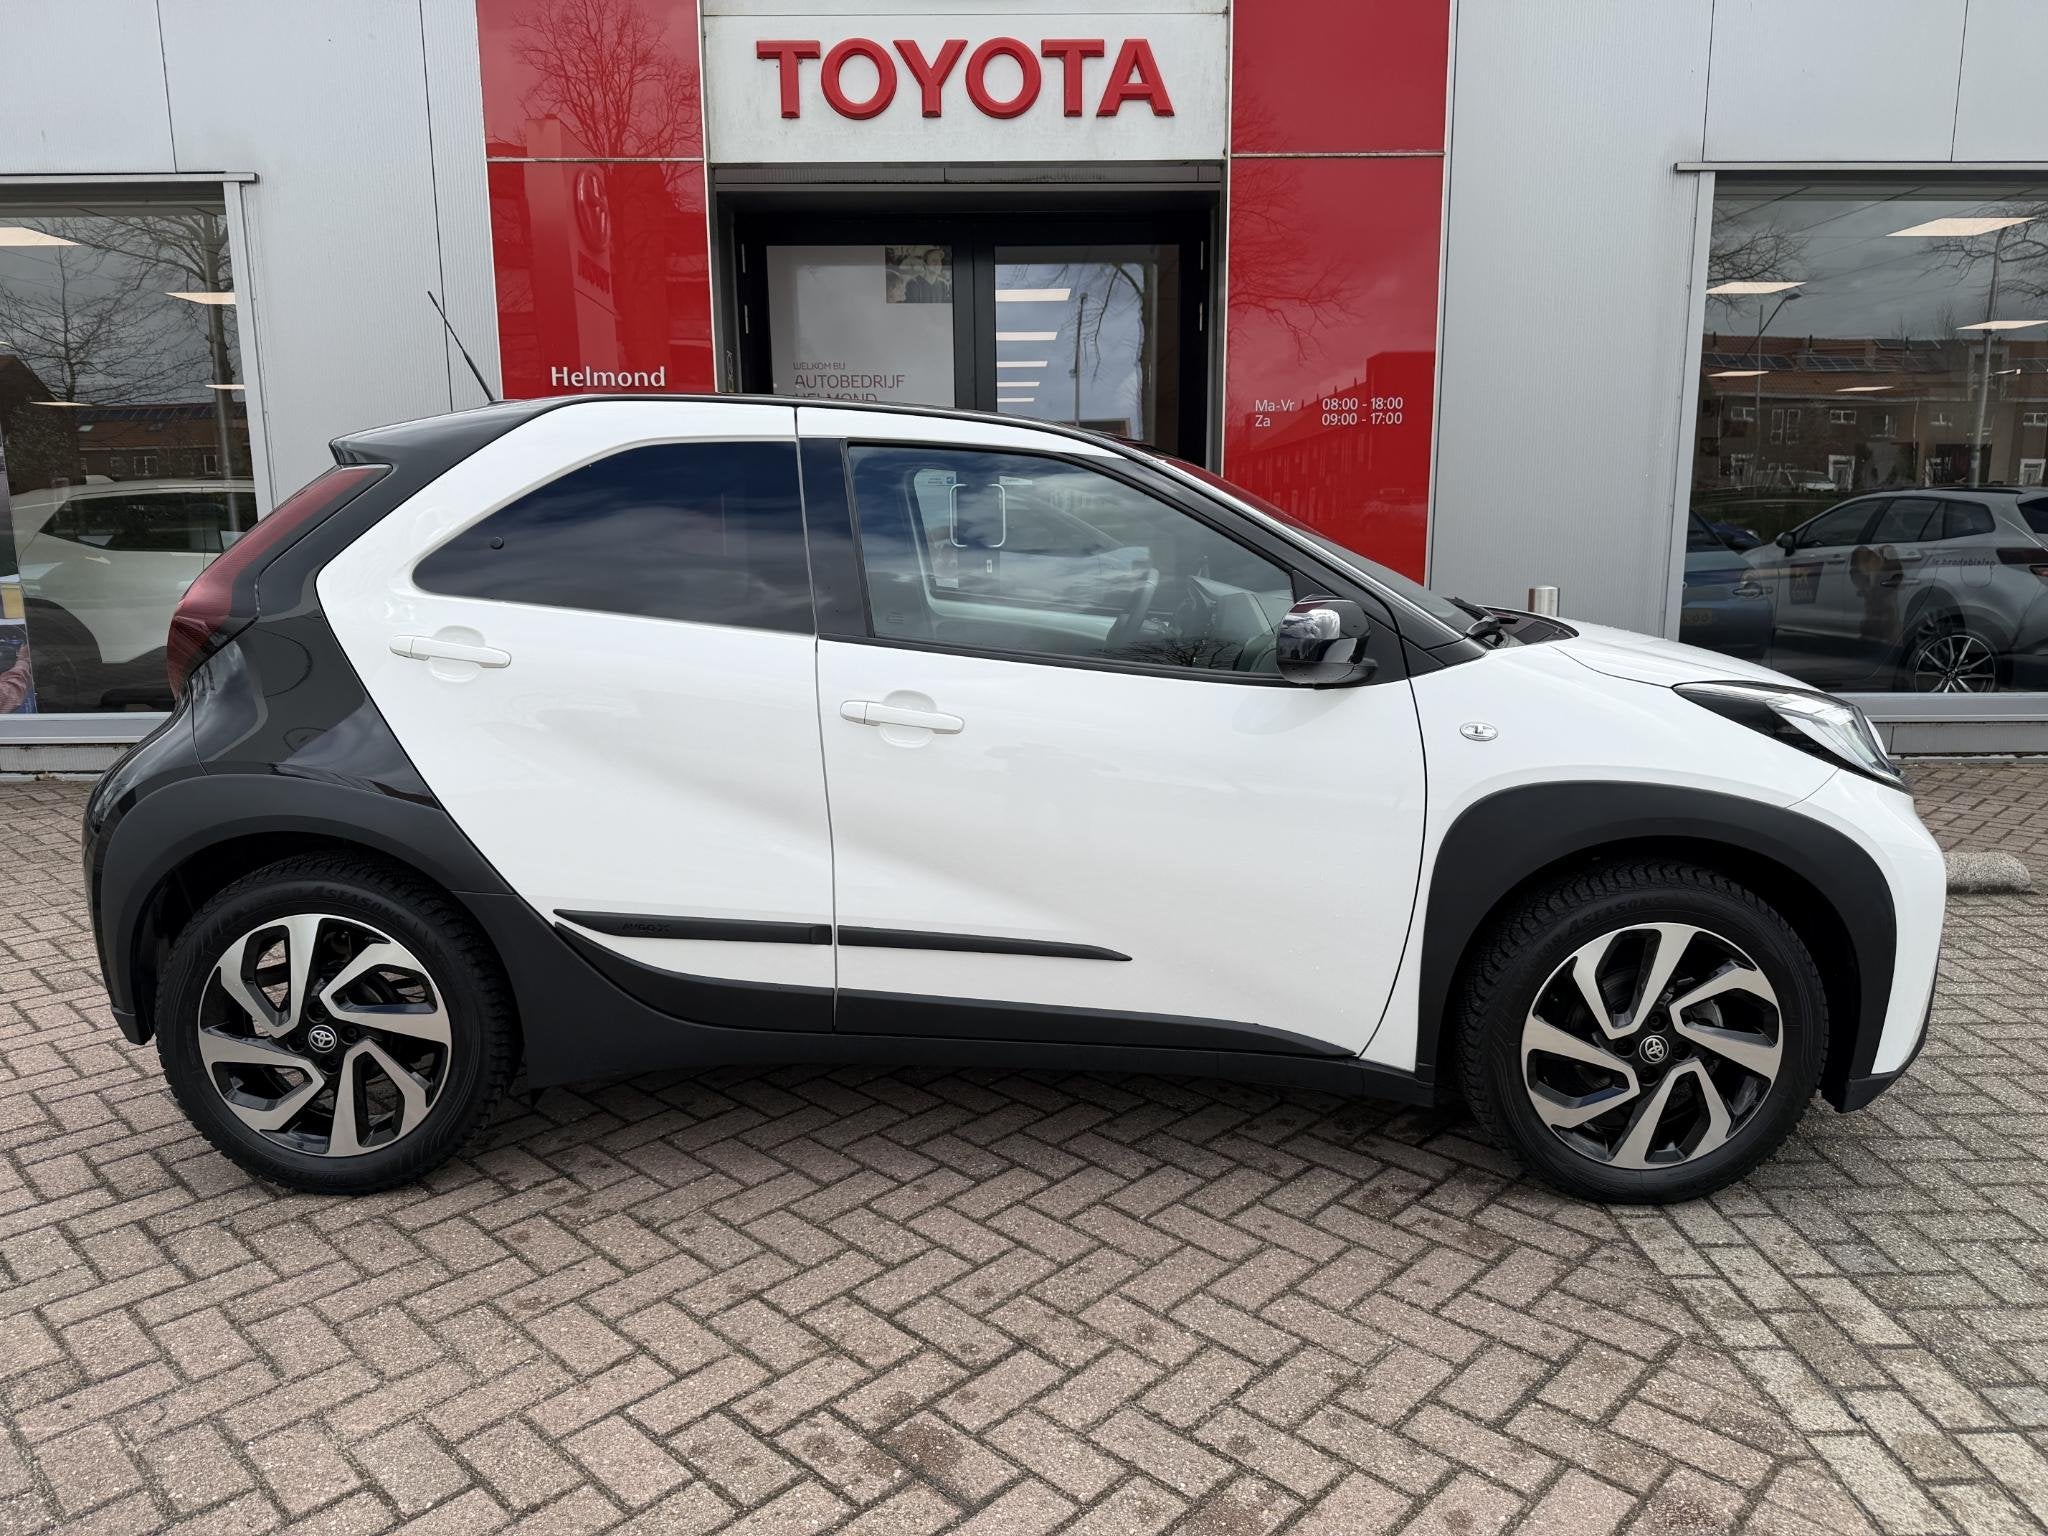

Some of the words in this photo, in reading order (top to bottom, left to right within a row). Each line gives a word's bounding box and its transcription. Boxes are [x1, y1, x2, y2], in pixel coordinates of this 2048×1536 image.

[756, 37, 1175, 120] TOYOTA
[793, 361, 831, 370] WELKOM
[551, 366, 666, 387] Helmond
[795, 374, 905, 389] AUTOBEDRIJF
[1255, 399, 1295, 412] Ma-Vr
[1322, 397, 1359, 411] 08:00
[1370, 396, 1404, 410] 18:00
[1255, 414, 1271, 427] Za
[1321, 412, 1358, 426] 09:00
[1370, 411, 1403, 425] 17:00
